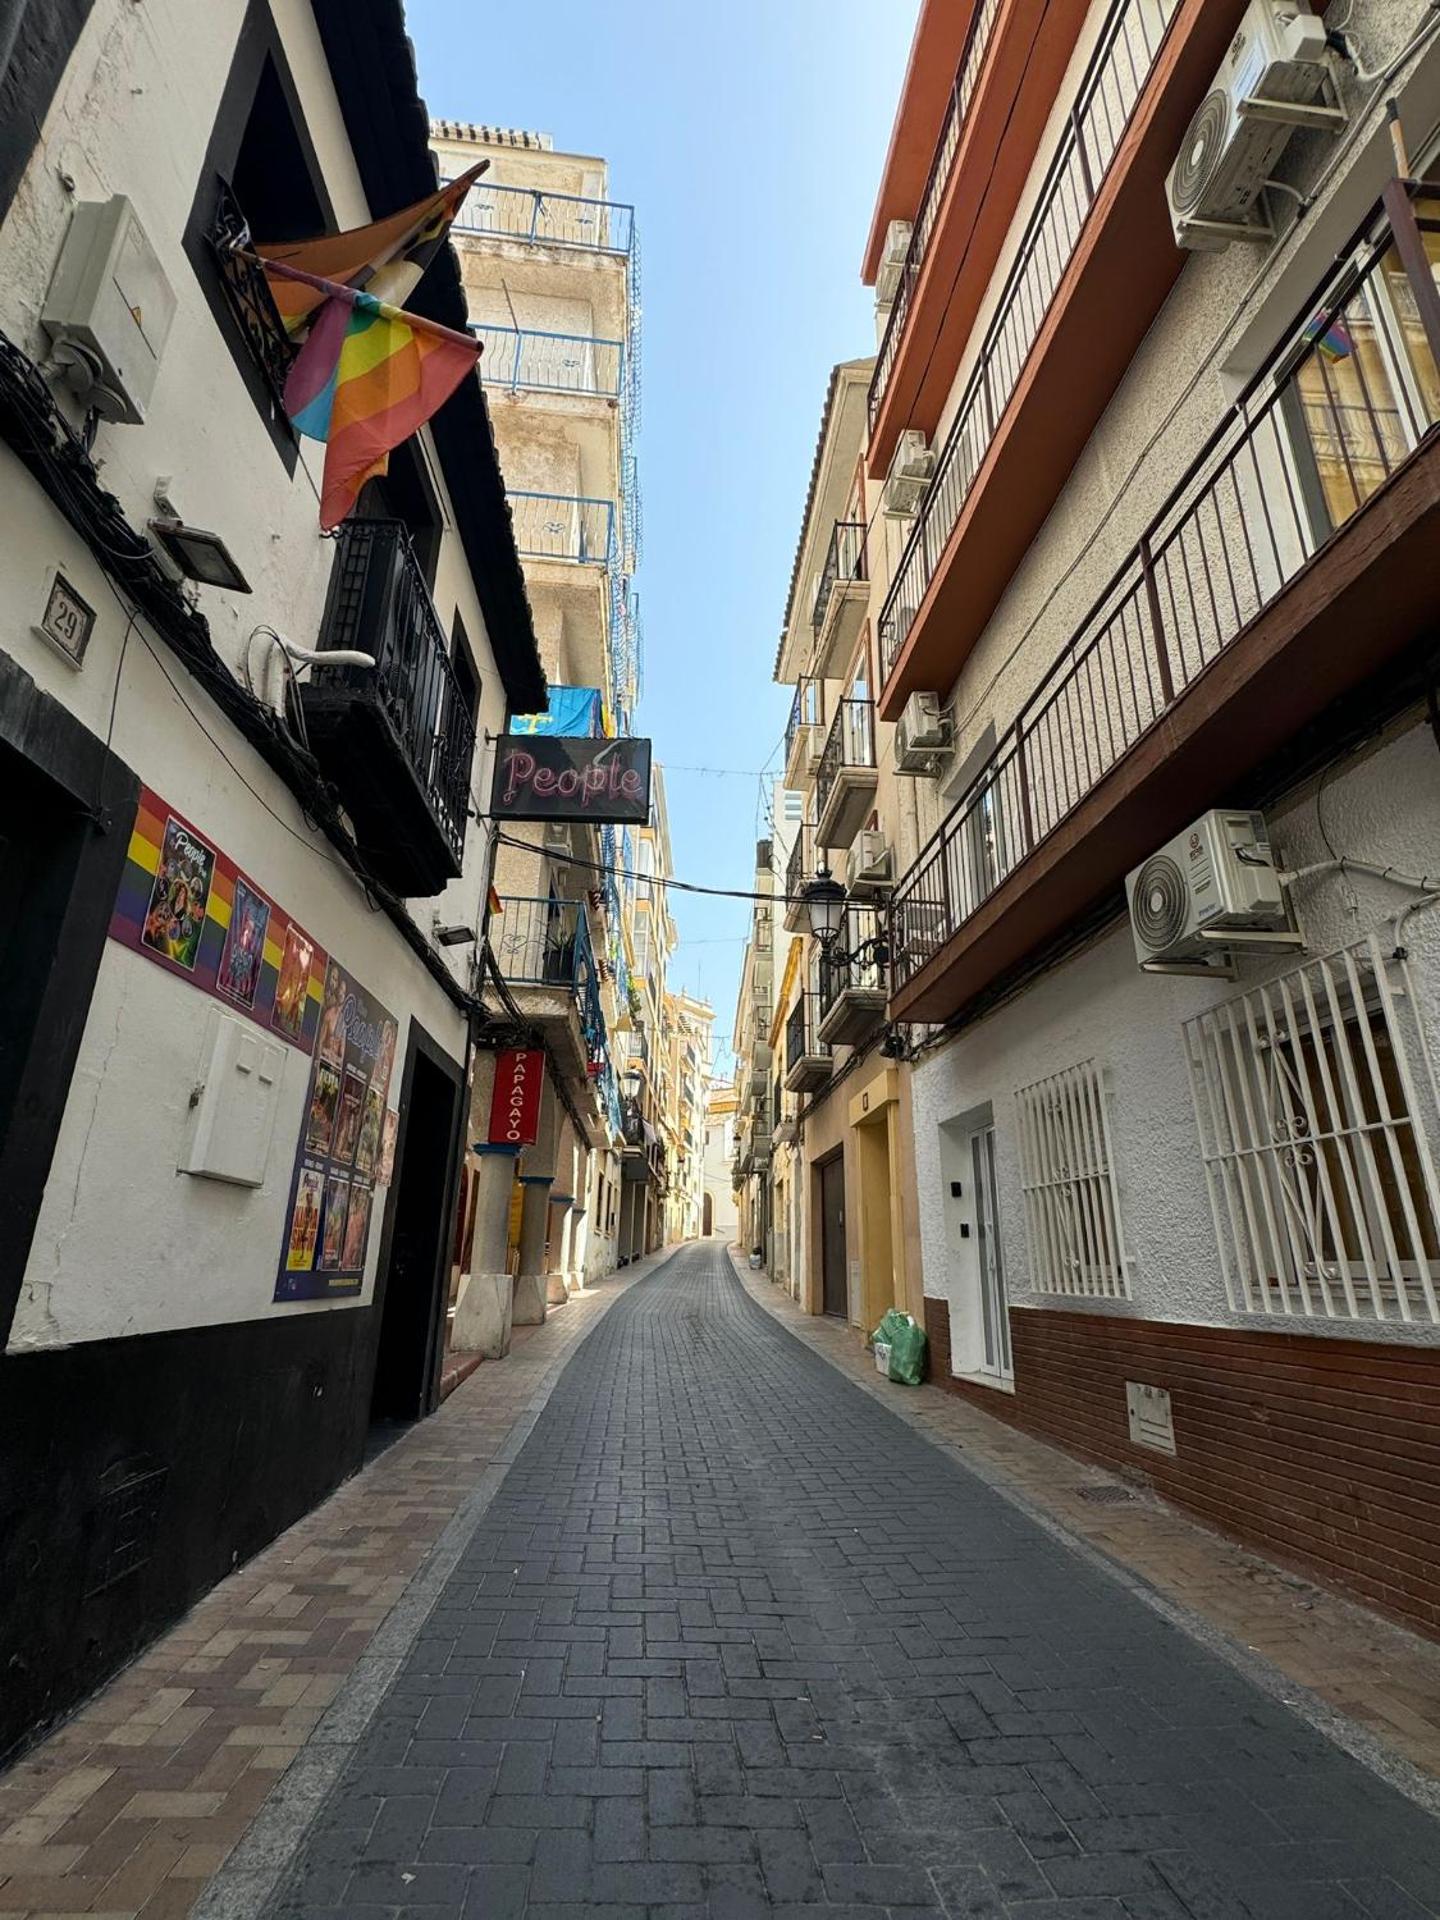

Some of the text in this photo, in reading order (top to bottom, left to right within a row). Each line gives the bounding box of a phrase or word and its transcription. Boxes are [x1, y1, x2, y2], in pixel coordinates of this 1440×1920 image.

[54, 601, 77, 639] 29
[503, 749, 643, 807] People
[506, 1052, 527, 1140] PAPAGAYO
